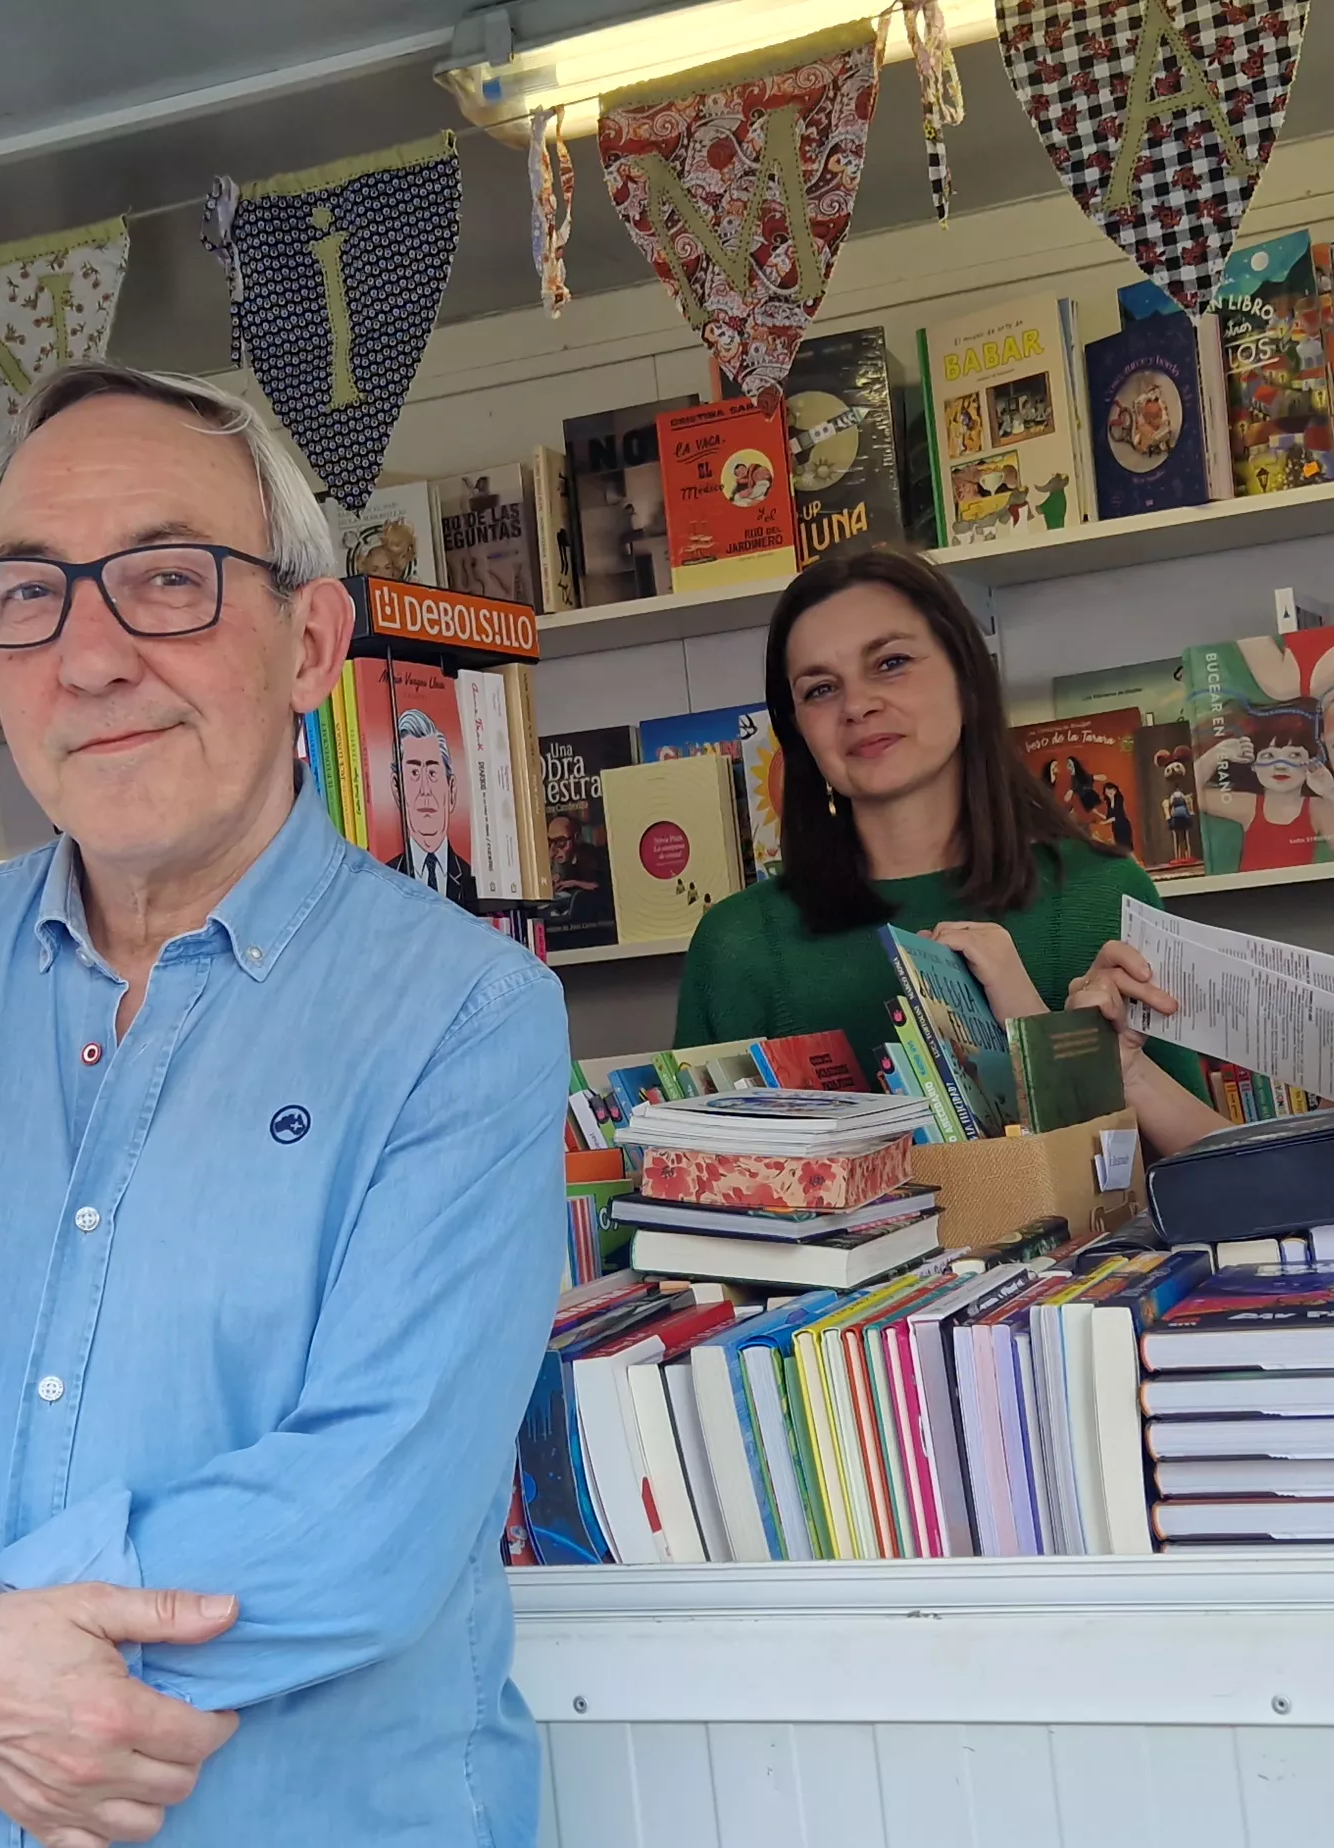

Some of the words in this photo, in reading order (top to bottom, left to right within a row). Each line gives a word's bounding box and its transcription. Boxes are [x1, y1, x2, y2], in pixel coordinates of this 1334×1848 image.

[1227, 295, 1274, 321] LIBRO
[944, 329, 1045, 382] BABAR
[492, 504, 519, 521] LAS
[445, 519, 521, 550] EGUNTAS
[726, 535, 783, 554] JARDINERO
[799, 501, 868, 565] LUNA
[1204, 652, 1224, 714] BUCEAR
[1212, 716, 1225, 738] EN
[551, 742, 573, 758] Una
[925, 1081, 955, 1134] ABECEDARIO
